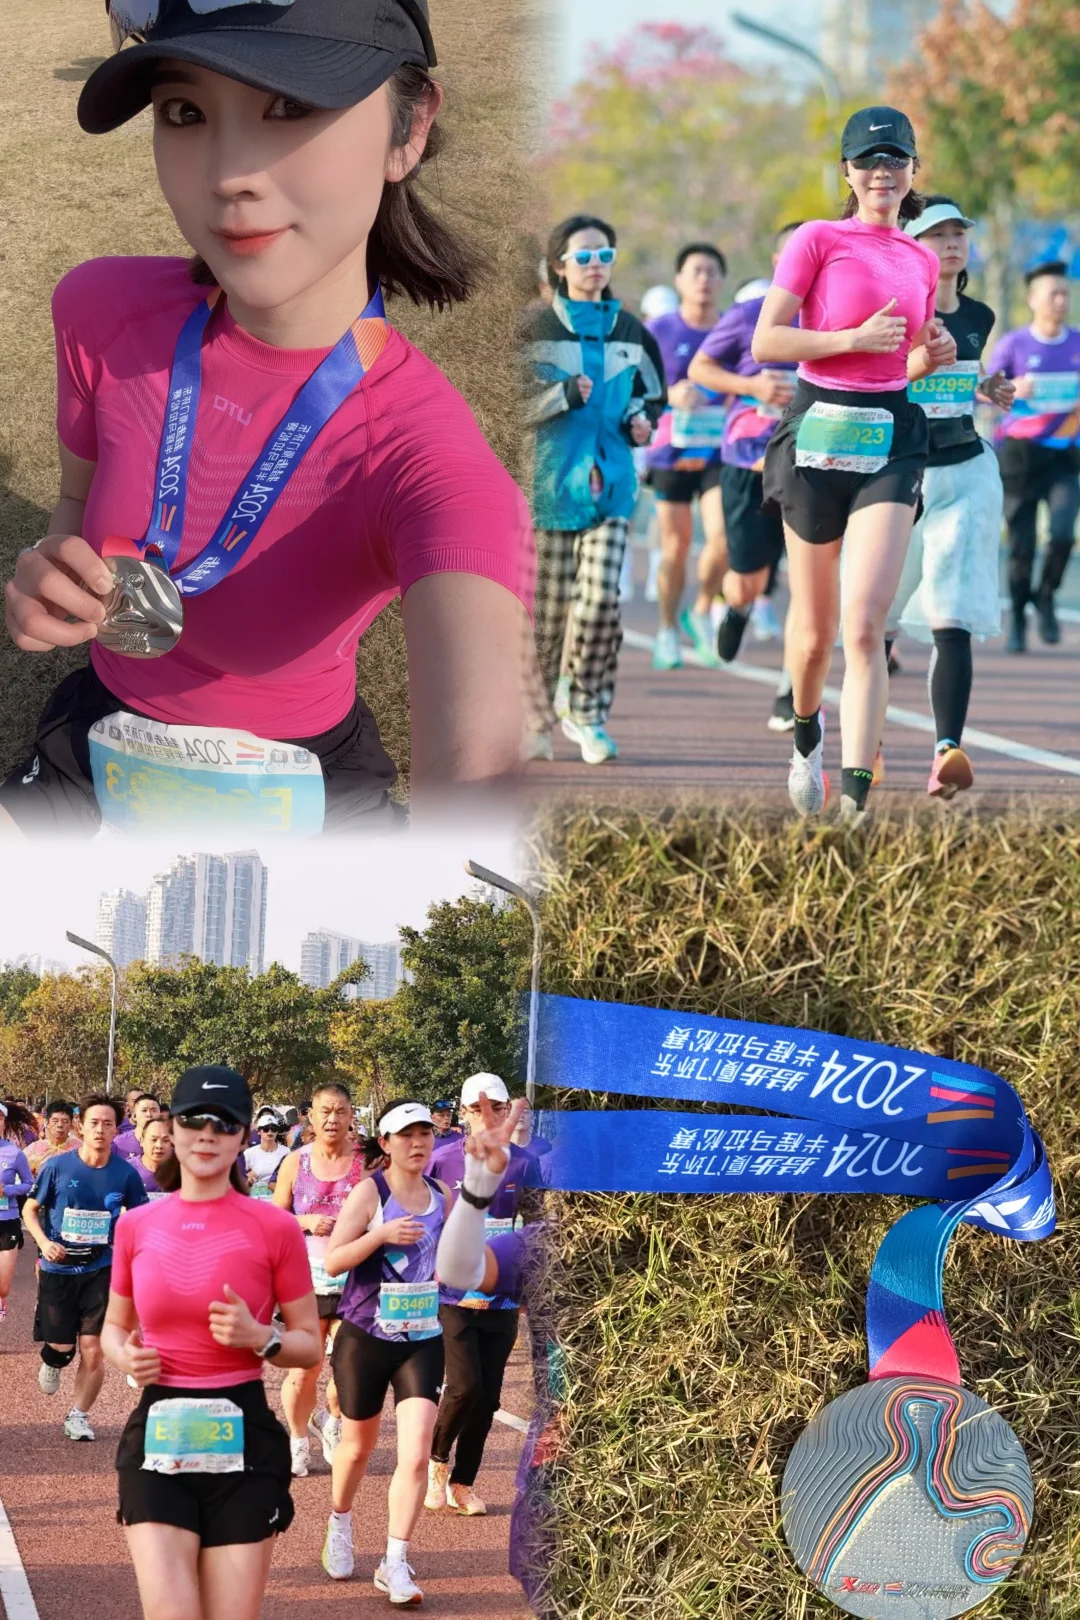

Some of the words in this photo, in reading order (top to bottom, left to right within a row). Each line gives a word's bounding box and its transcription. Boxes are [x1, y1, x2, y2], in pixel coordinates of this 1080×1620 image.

[661, 1025, 820, 1067] 半程马拉松赛
[651, 1053, 809, 1092] 特步厦门环东
[809, 1049, 927, 1116] 2024
[669, 1127, 829, 1154] 半程马拉松赛
[823, 1132, 924, 1178] 2024
[658, 1152, 820, 1177] 特步厦门环东
